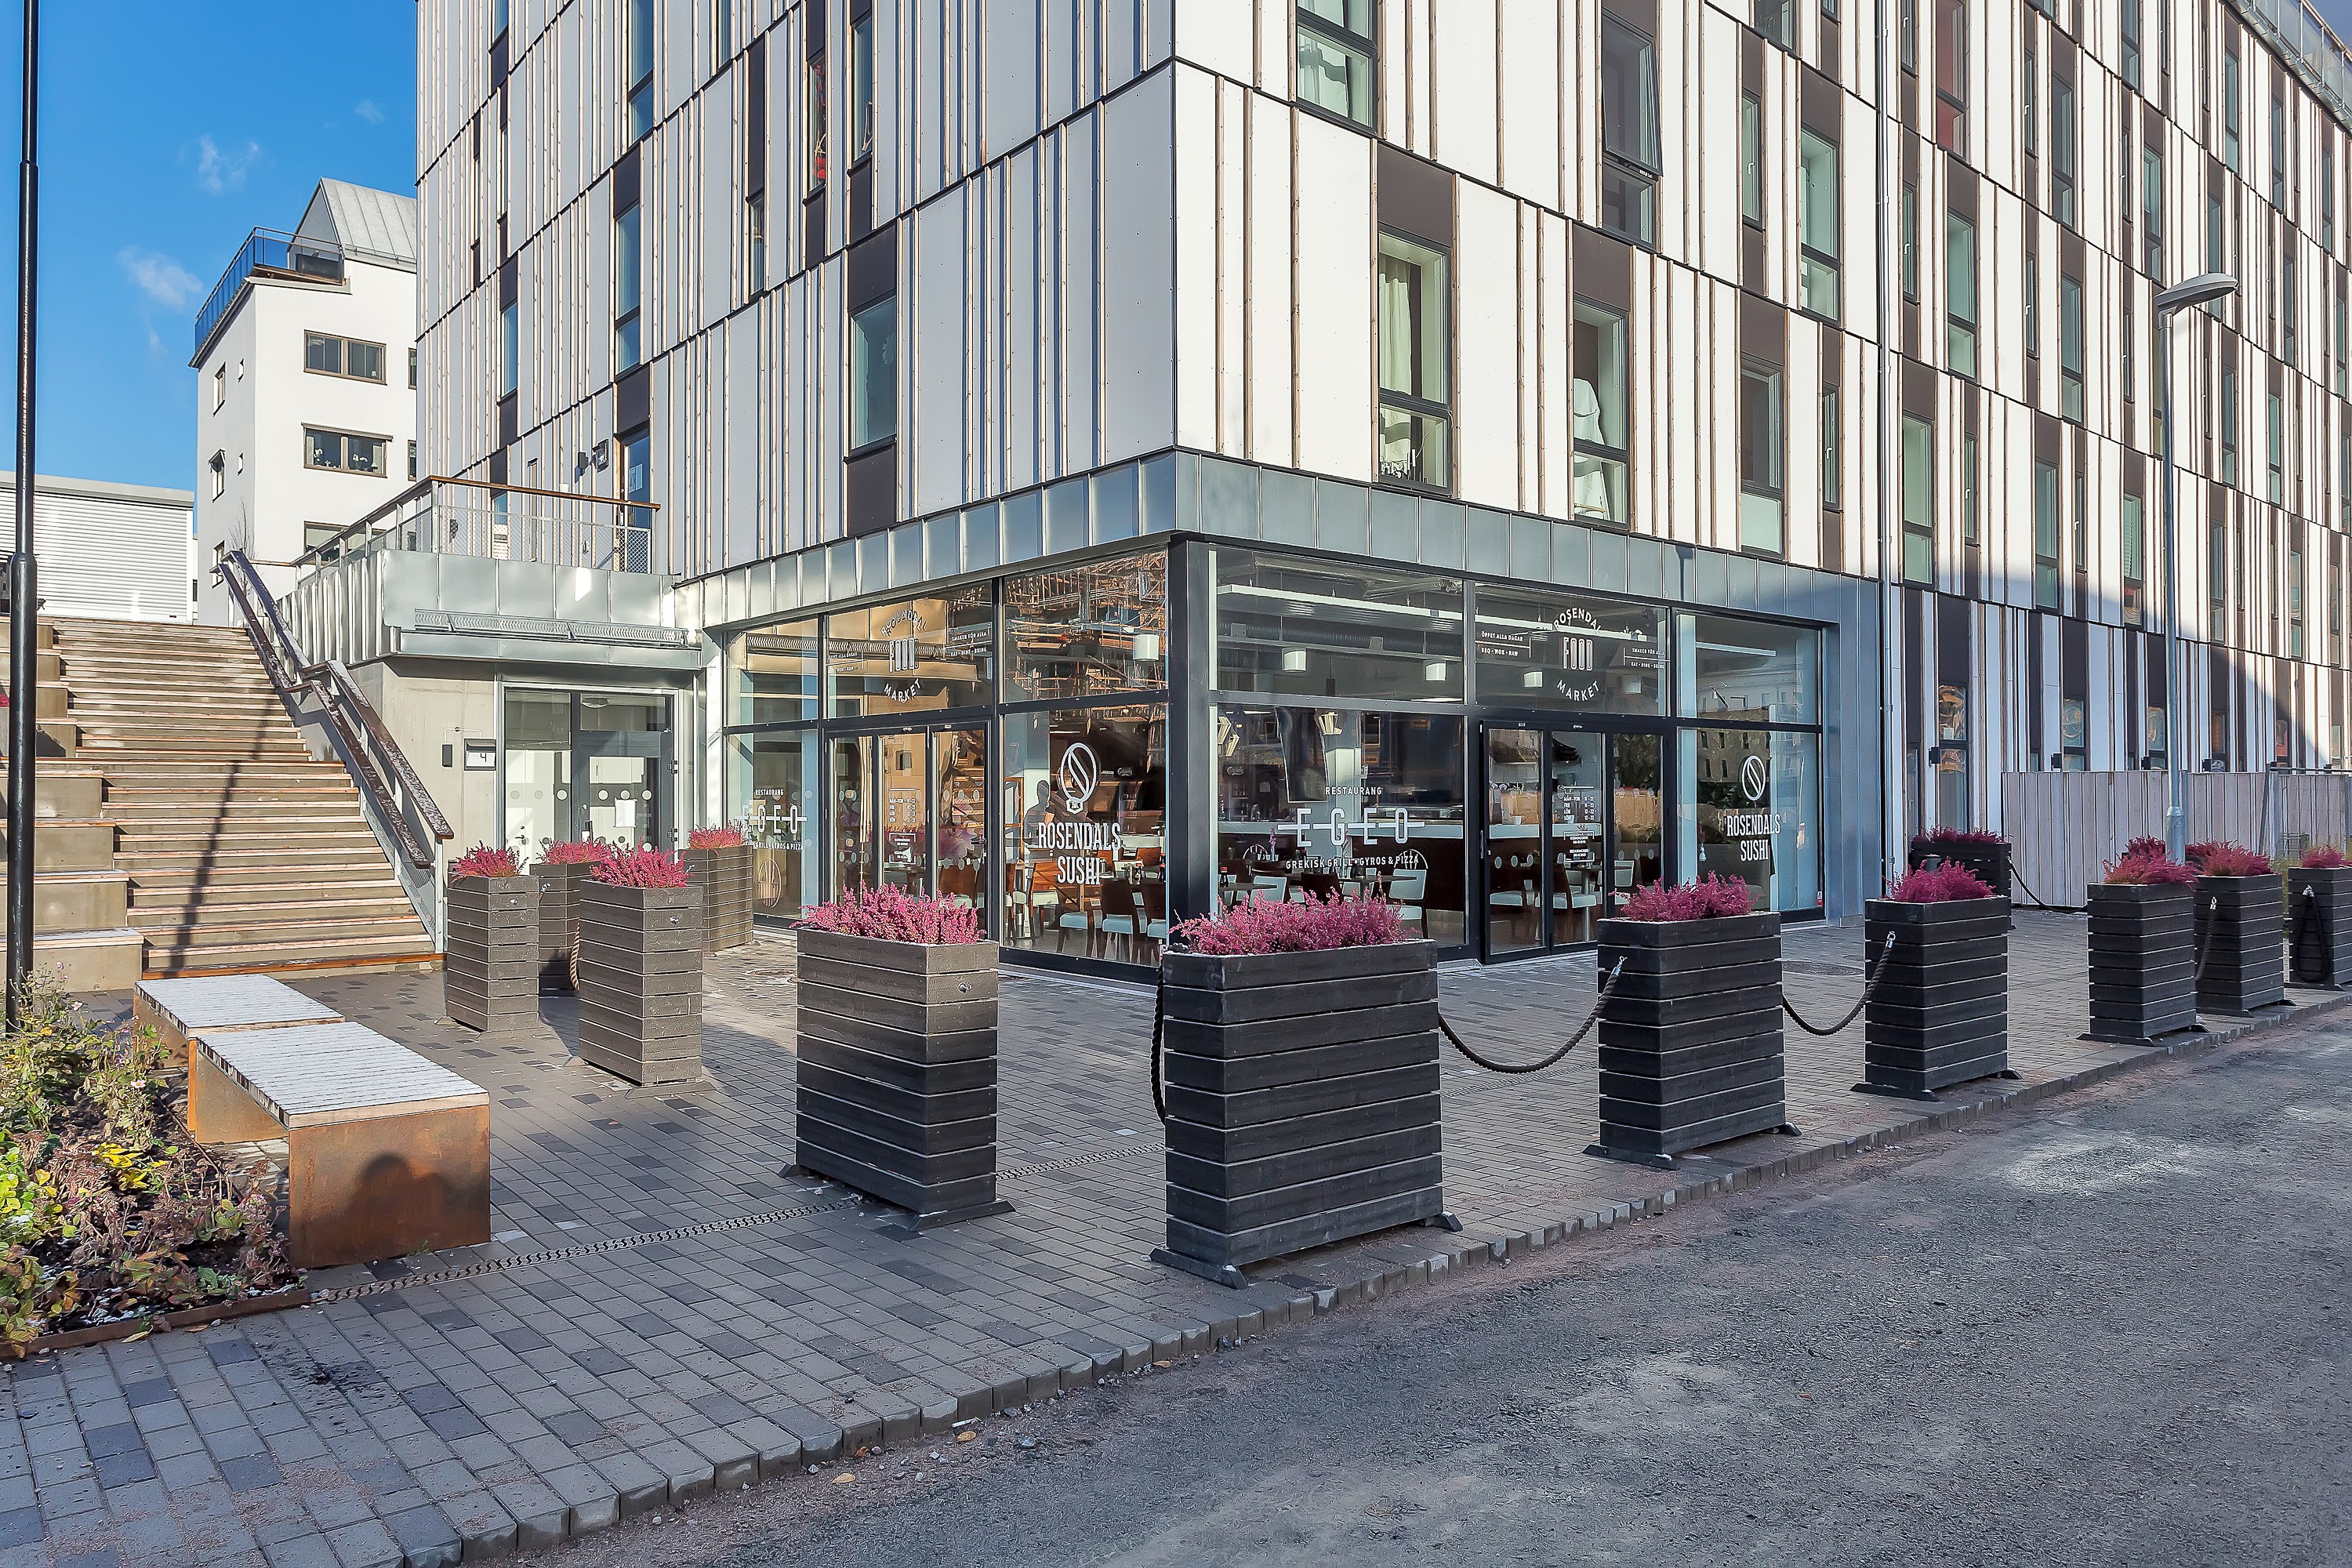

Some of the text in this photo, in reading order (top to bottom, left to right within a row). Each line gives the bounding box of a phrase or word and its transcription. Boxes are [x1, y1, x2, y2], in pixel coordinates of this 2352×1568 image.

[1553, 608, 1601, 636] ROSENDAL
[889, 637, 915, 672] FOOD
[1563, 637, 1593, 671] FOOD
[884, 678, 921, 702] MARKET
[1557, 679, 1599, 702] MARKET
[480, 753, 487, 762] 4
[1325, 786, 1382, 795] RESTAURANG
[1037, 822, 1121, 851] ROSENDALS
[1292, 808, 1413, 848] EGEO
[1726, 813, 1780, 837] ROSENDALS
[1286, 855, 1419, 869] GREKISK GRILL GYROS & PIZZA
[1740, 839, 1769, 862] SUSHI
[1057, 855, 1101, 885] SUSHI
